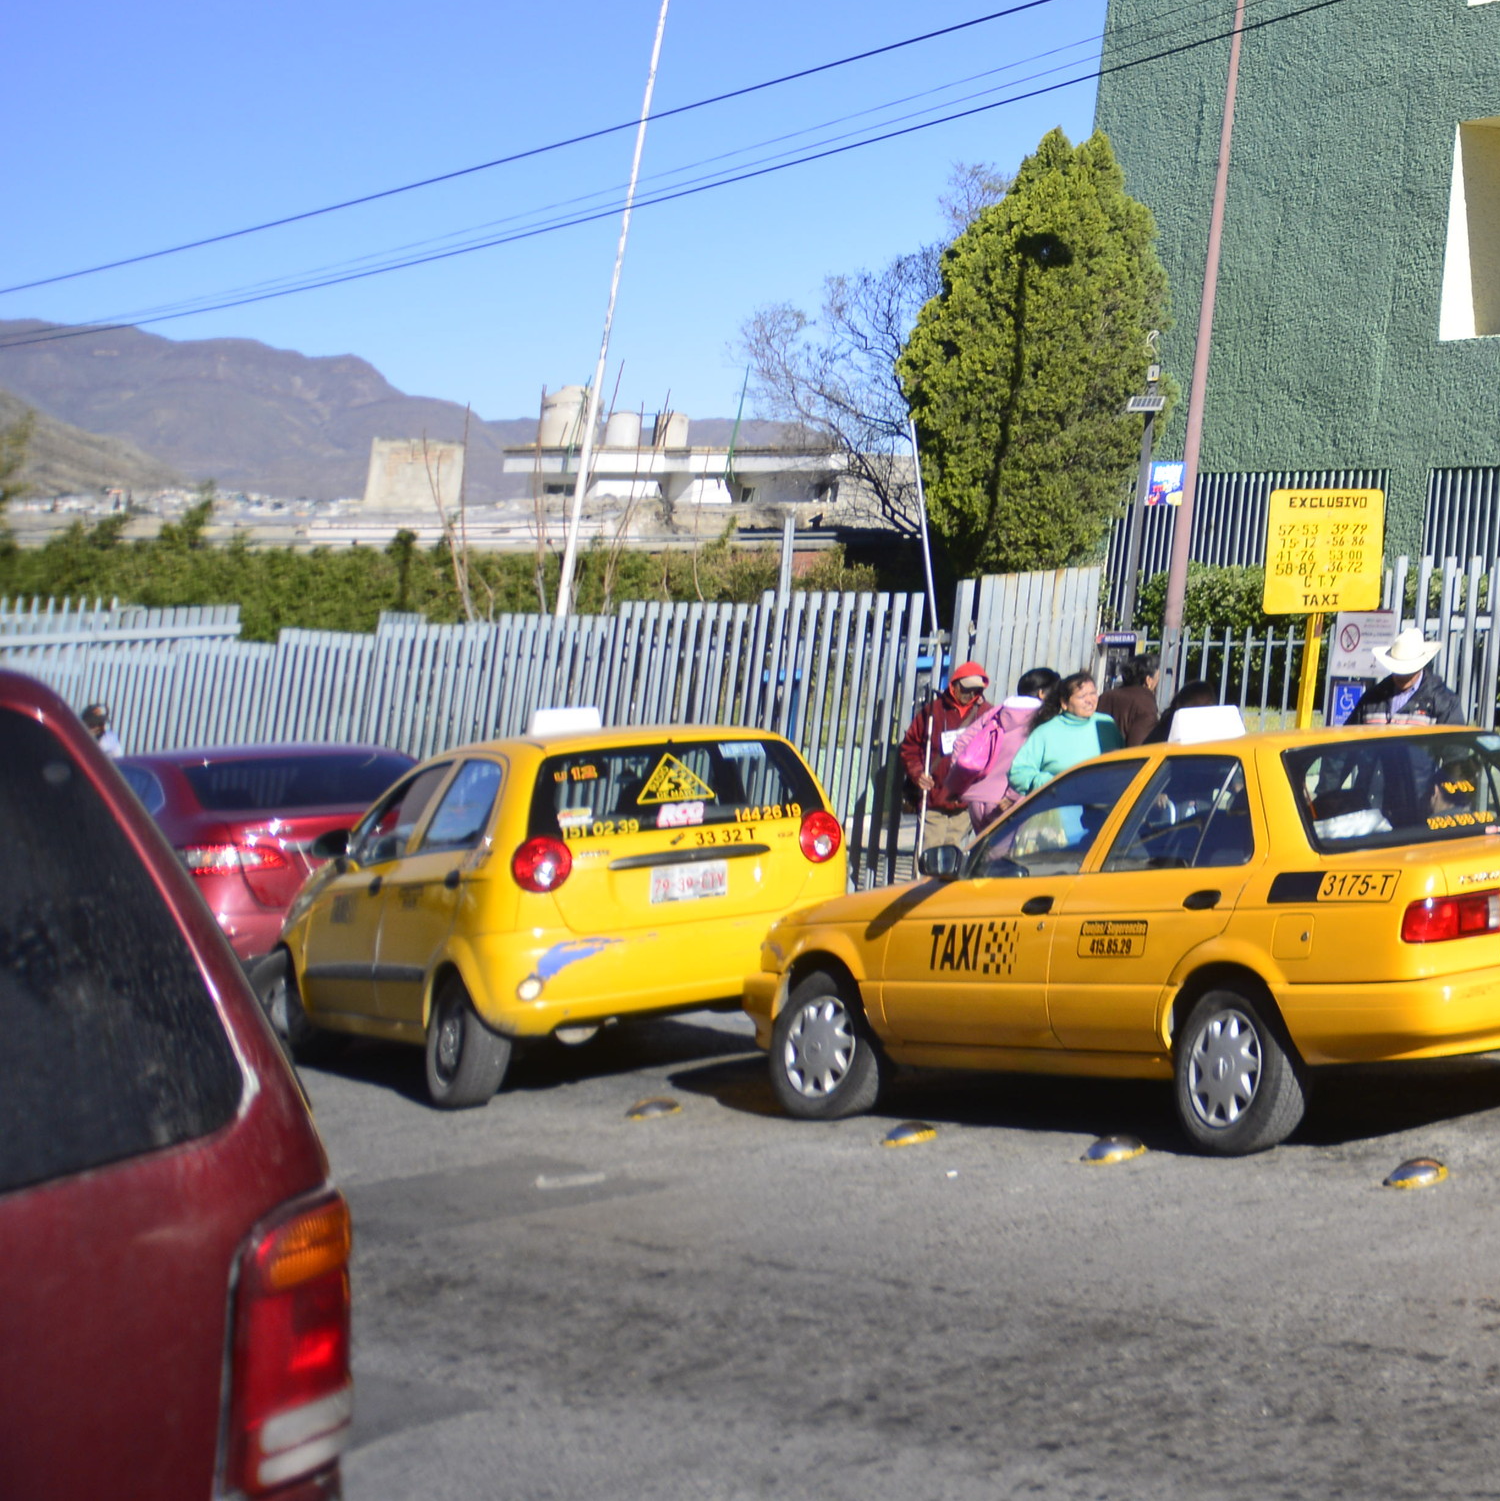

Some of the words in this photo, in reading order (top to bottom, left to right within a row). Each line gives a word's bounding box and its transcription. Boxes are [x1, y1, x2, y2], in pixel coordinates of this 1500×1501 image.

[1289, 496, 1368, 508] EXCLUSIVO
[1302, 593, 1340, 607] TAXI
[571, 764, 598, 781] 12
[734, 805, 761, 823] 144
[762, 804, 783, 820] 26
[784, 802, 802, 817] 19
[562, 824, 588, 838] 151
[592, 820, 615, 836] 02
[617, 818, 639, 833] 39
[695, 832, 716, 846] 33
[722, 829, 743, 842] 32
[747, 826, 757, 841] T
[1322, 873, 1394, 896] 3175-T
[930, 923, 984, 971] TAXI
[1089, 938, 1132, 954] 415.85.29
